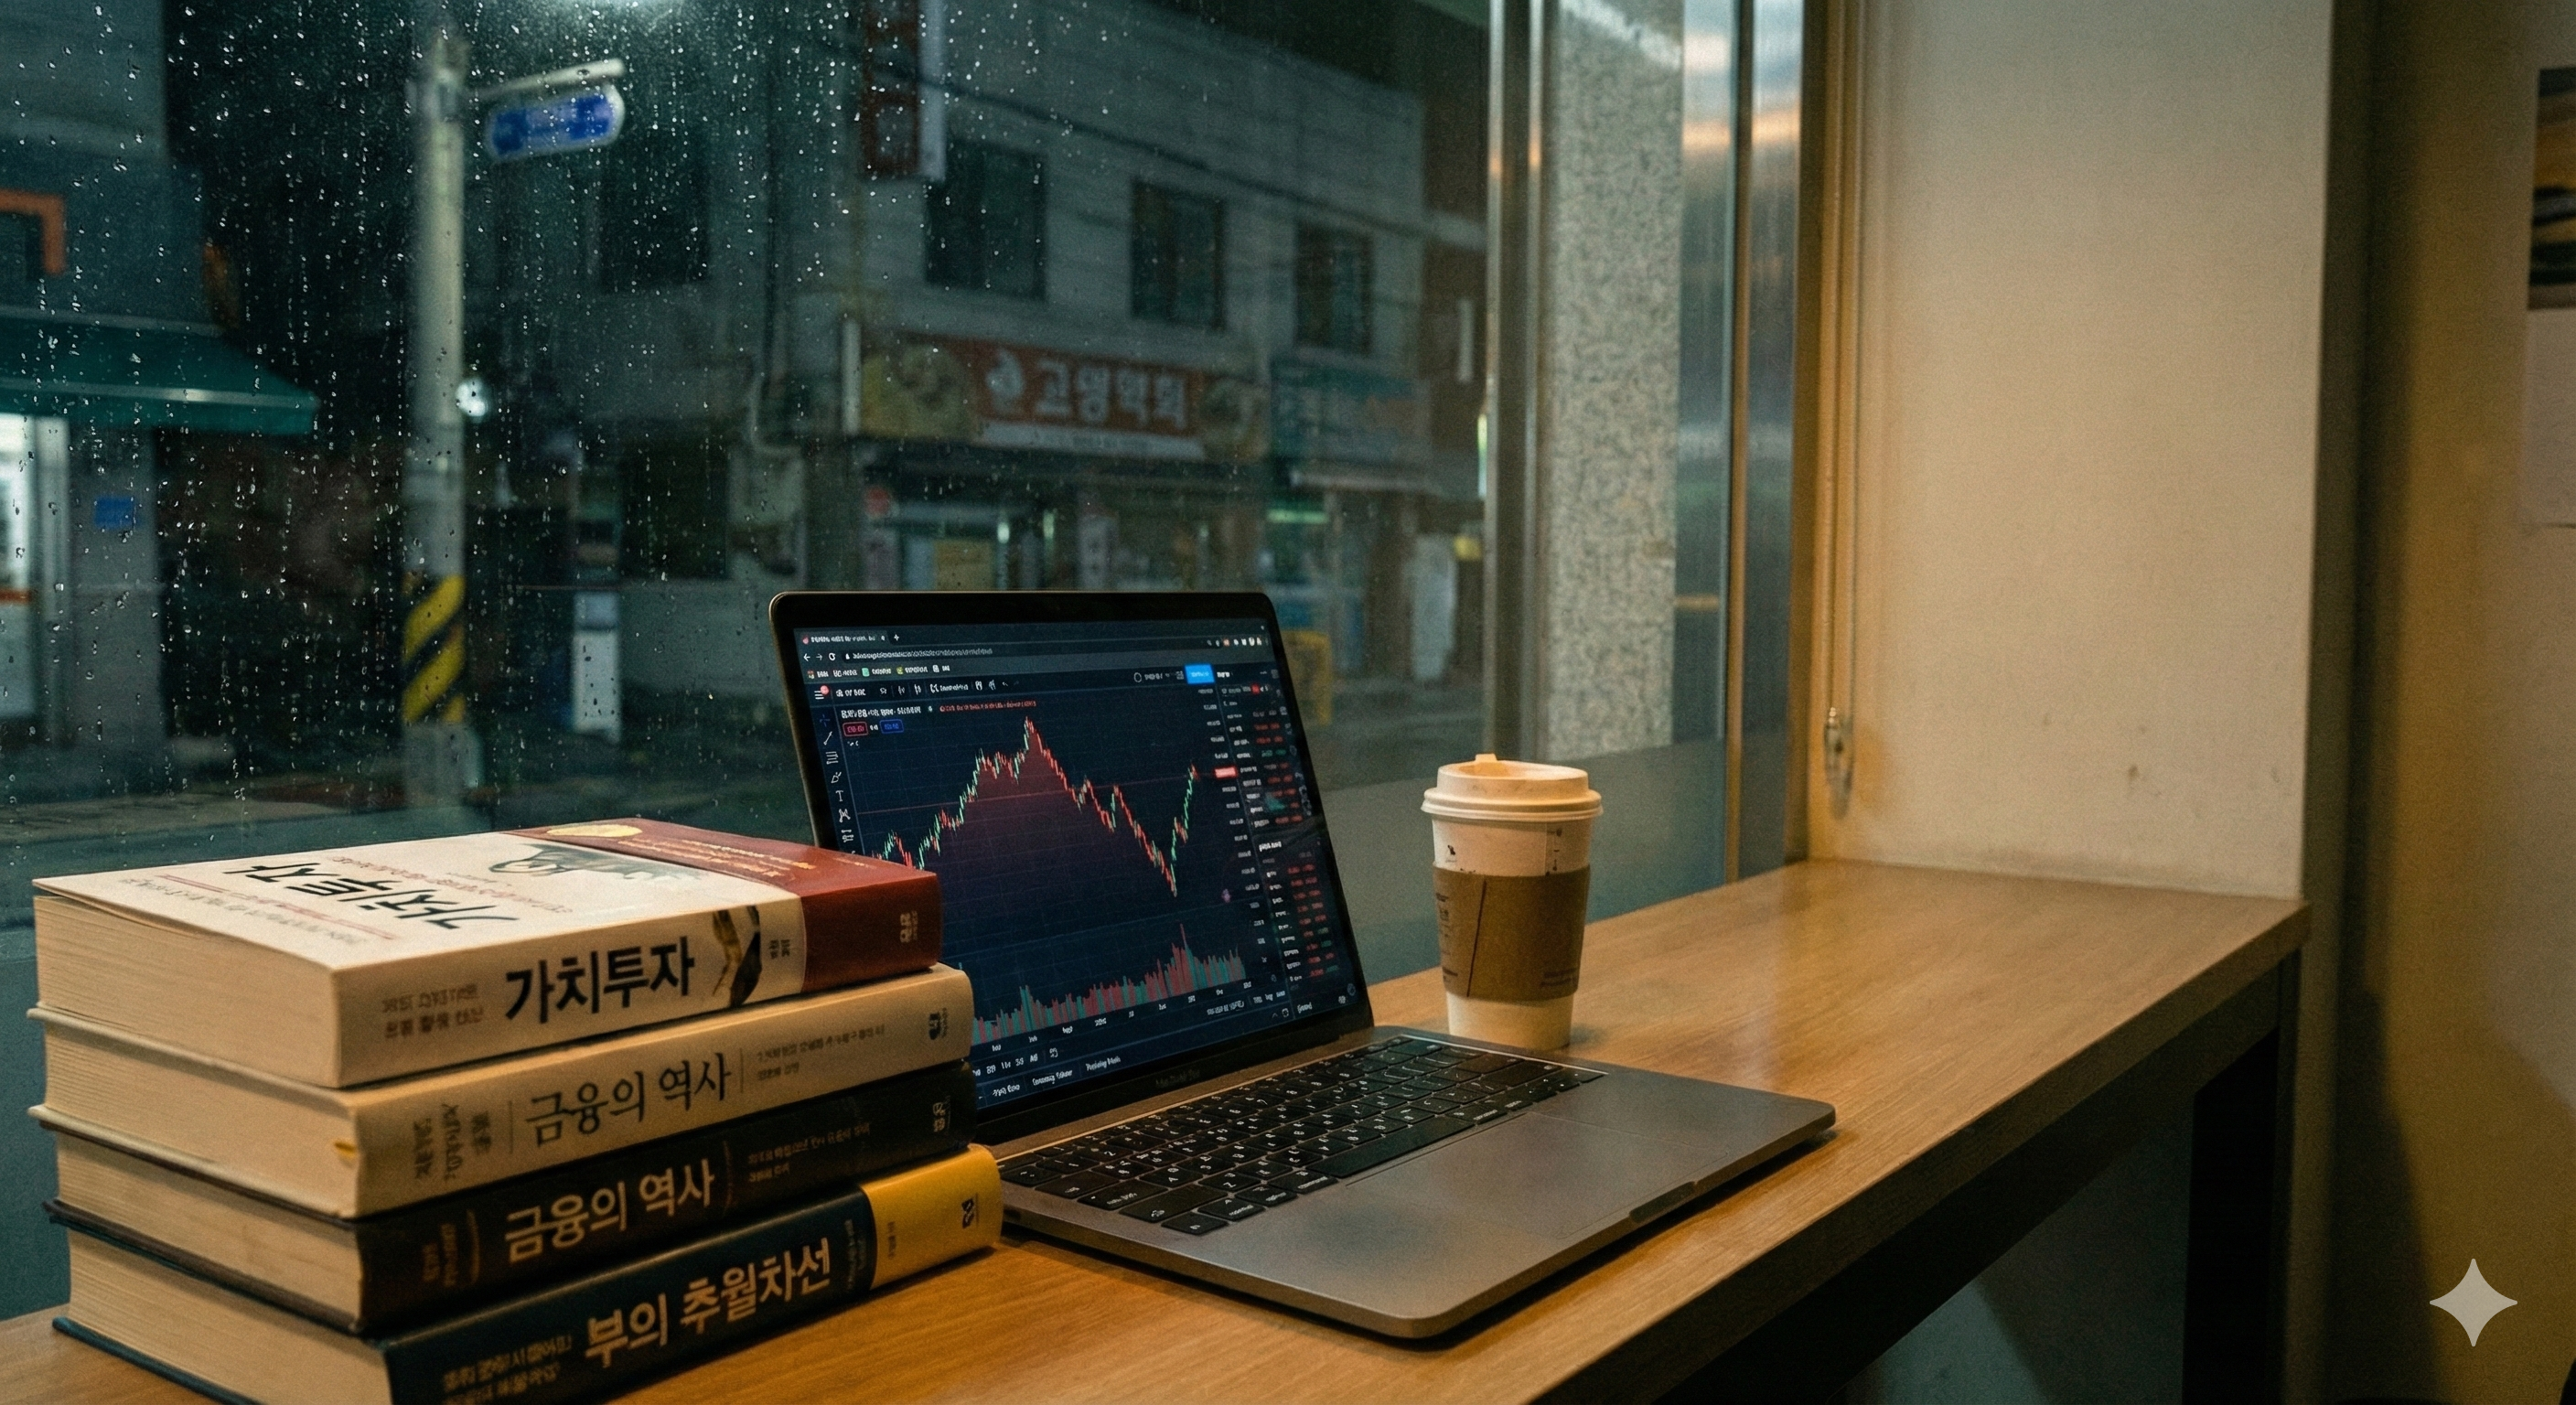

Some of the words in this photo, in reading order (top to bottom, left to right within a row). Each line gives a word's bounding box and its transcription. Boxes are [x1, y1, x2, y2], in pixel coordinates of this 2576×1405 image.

[222, 862, 521, 929] 가치투자
[505, 936, 695, 1024] 가치투자
[526, 1070, 646, 1148] 금융의
[659, 1052, 732, 1111] 역사
[505, 1181, 628, 1264] 금융의
[639, 1158, 715, 1217] 역사
[585, 1293, 669, 1368] 부의
[680, 1238, 832, 1335] 추월차선
